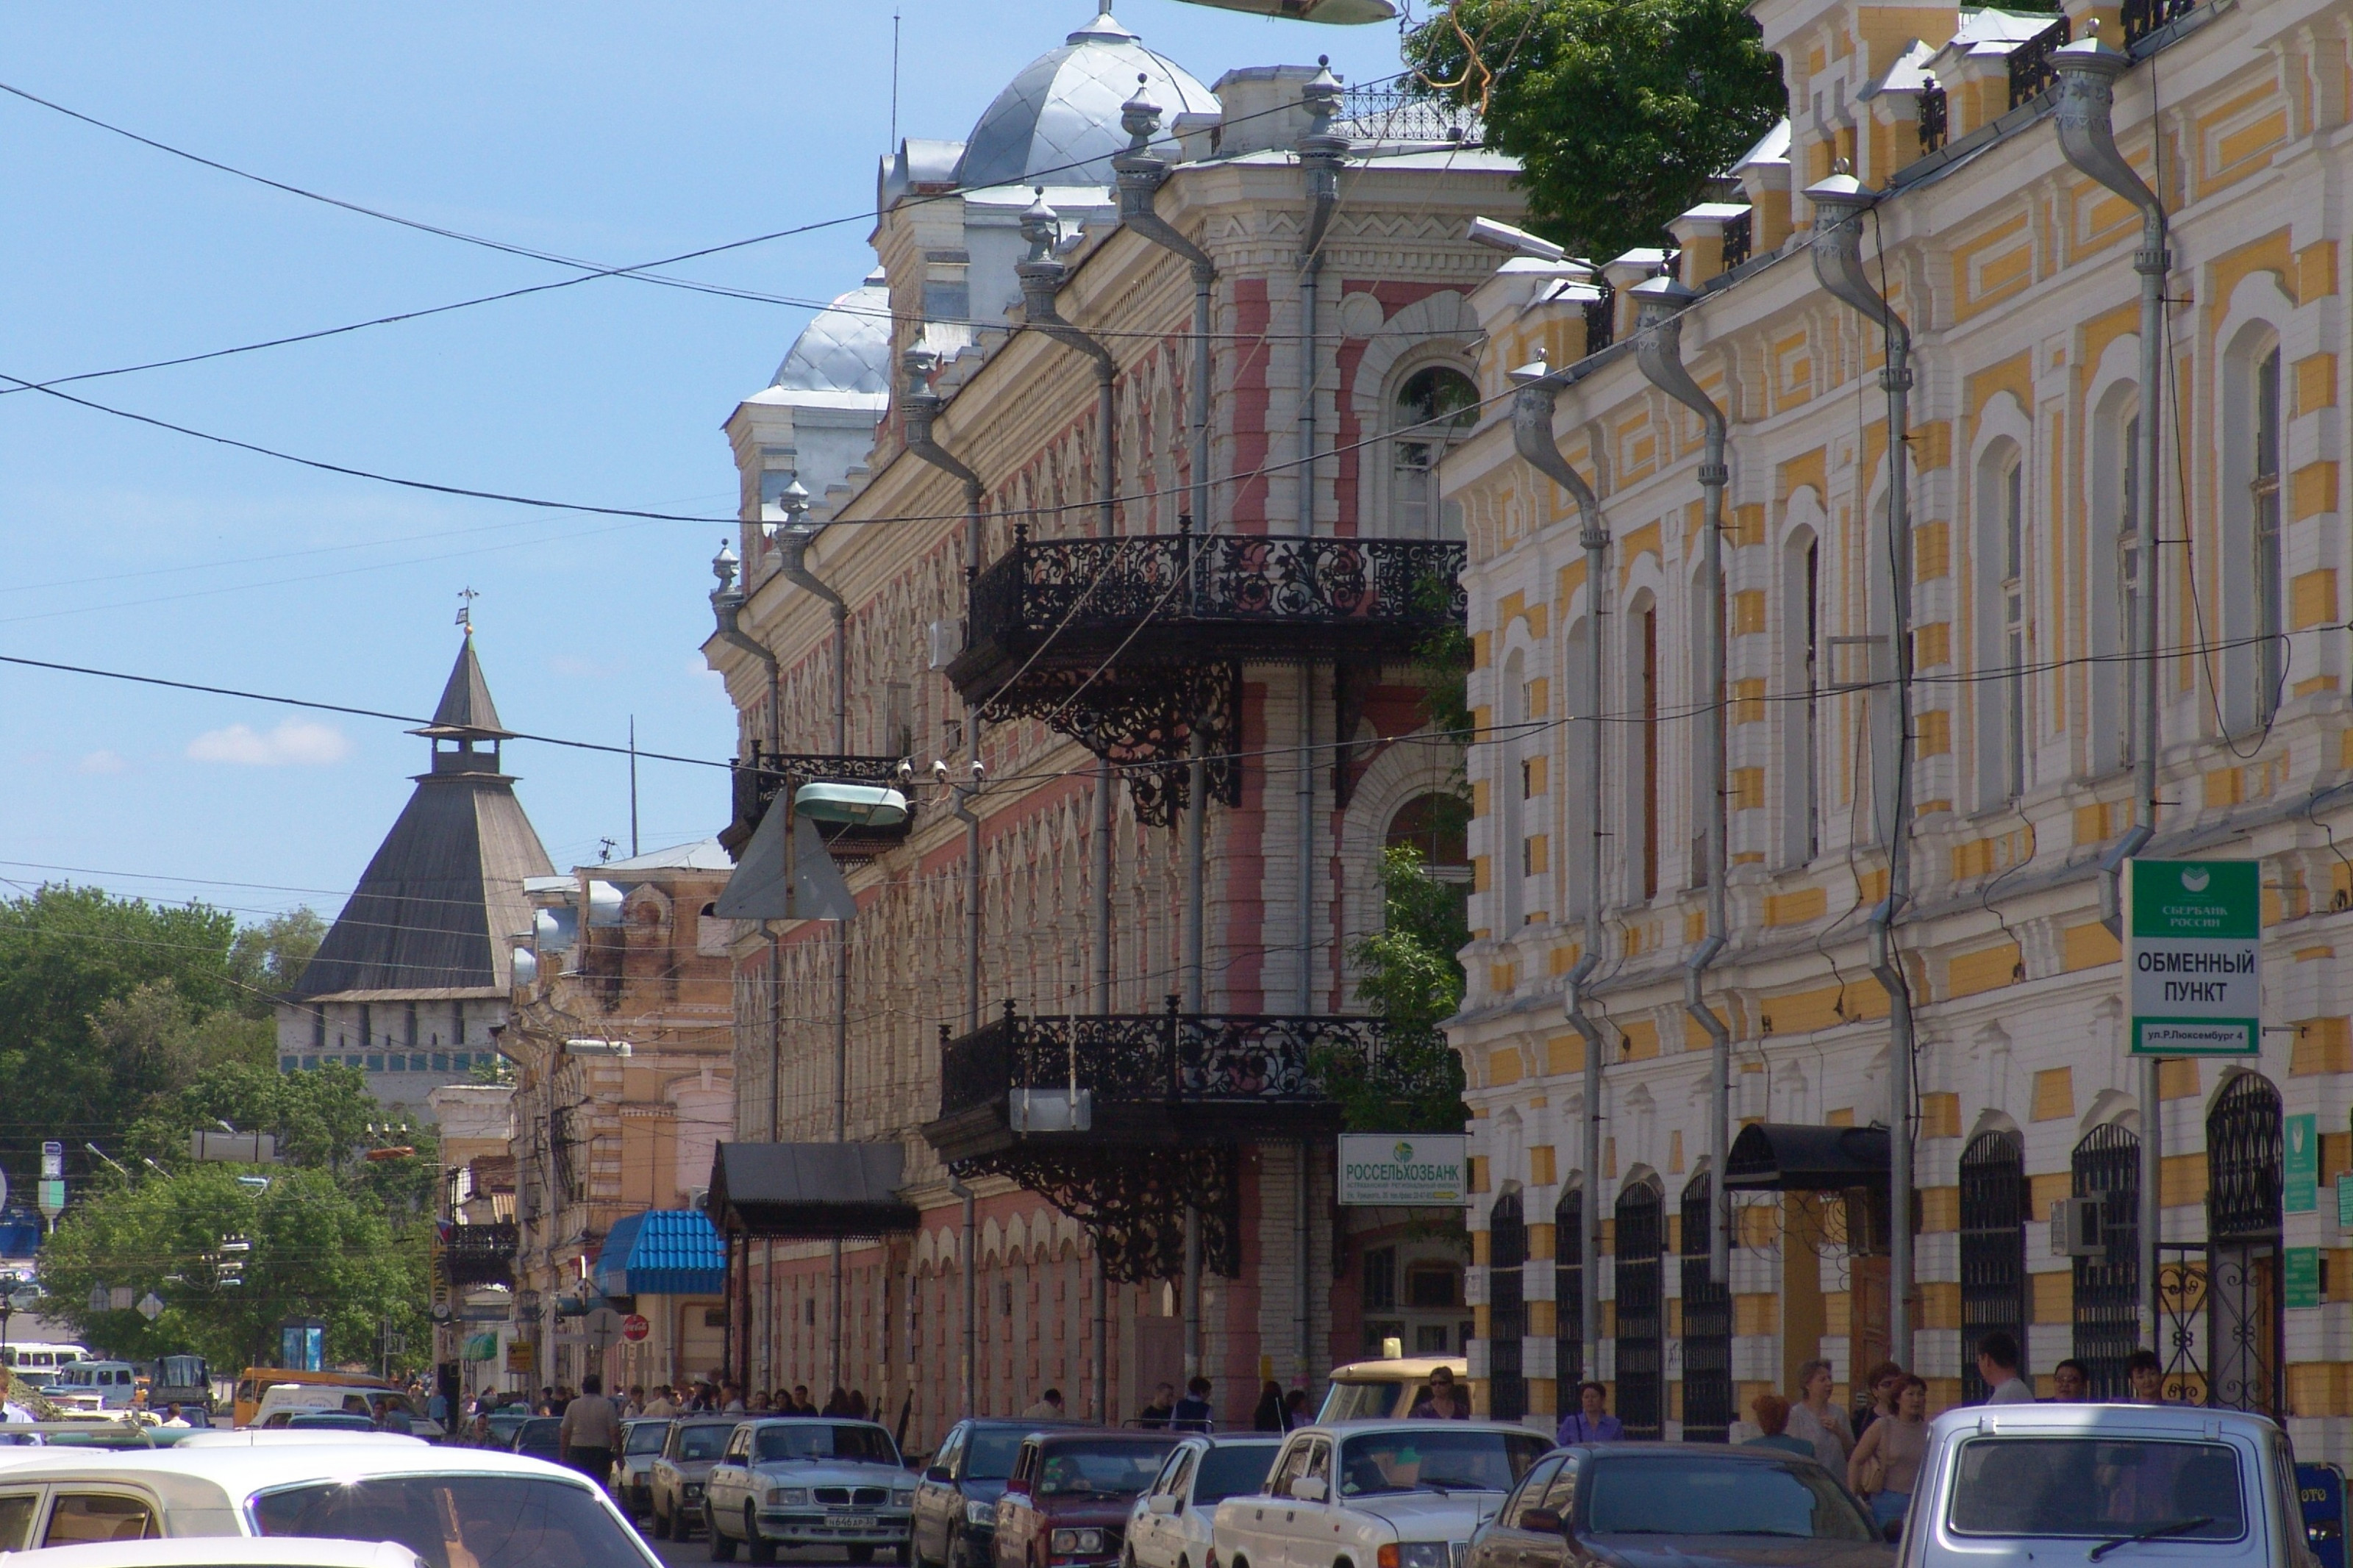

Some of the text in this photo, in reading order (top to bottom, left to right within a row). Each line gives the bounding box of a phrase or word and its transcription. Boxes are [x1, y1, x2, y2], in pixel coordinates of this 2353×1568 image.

[2163, 905, 2228, 916] СБЕРБАНК
[2170, 918, 2221, 928] РОССИИ
[2138, 949, 2254, 974] ОБМЕННЫЙ
[2164, 981, 2227, 1001] ПУНКТ
[1346, 1164, 1460, 1181] РОССЕЛЬХОЗБАНК
